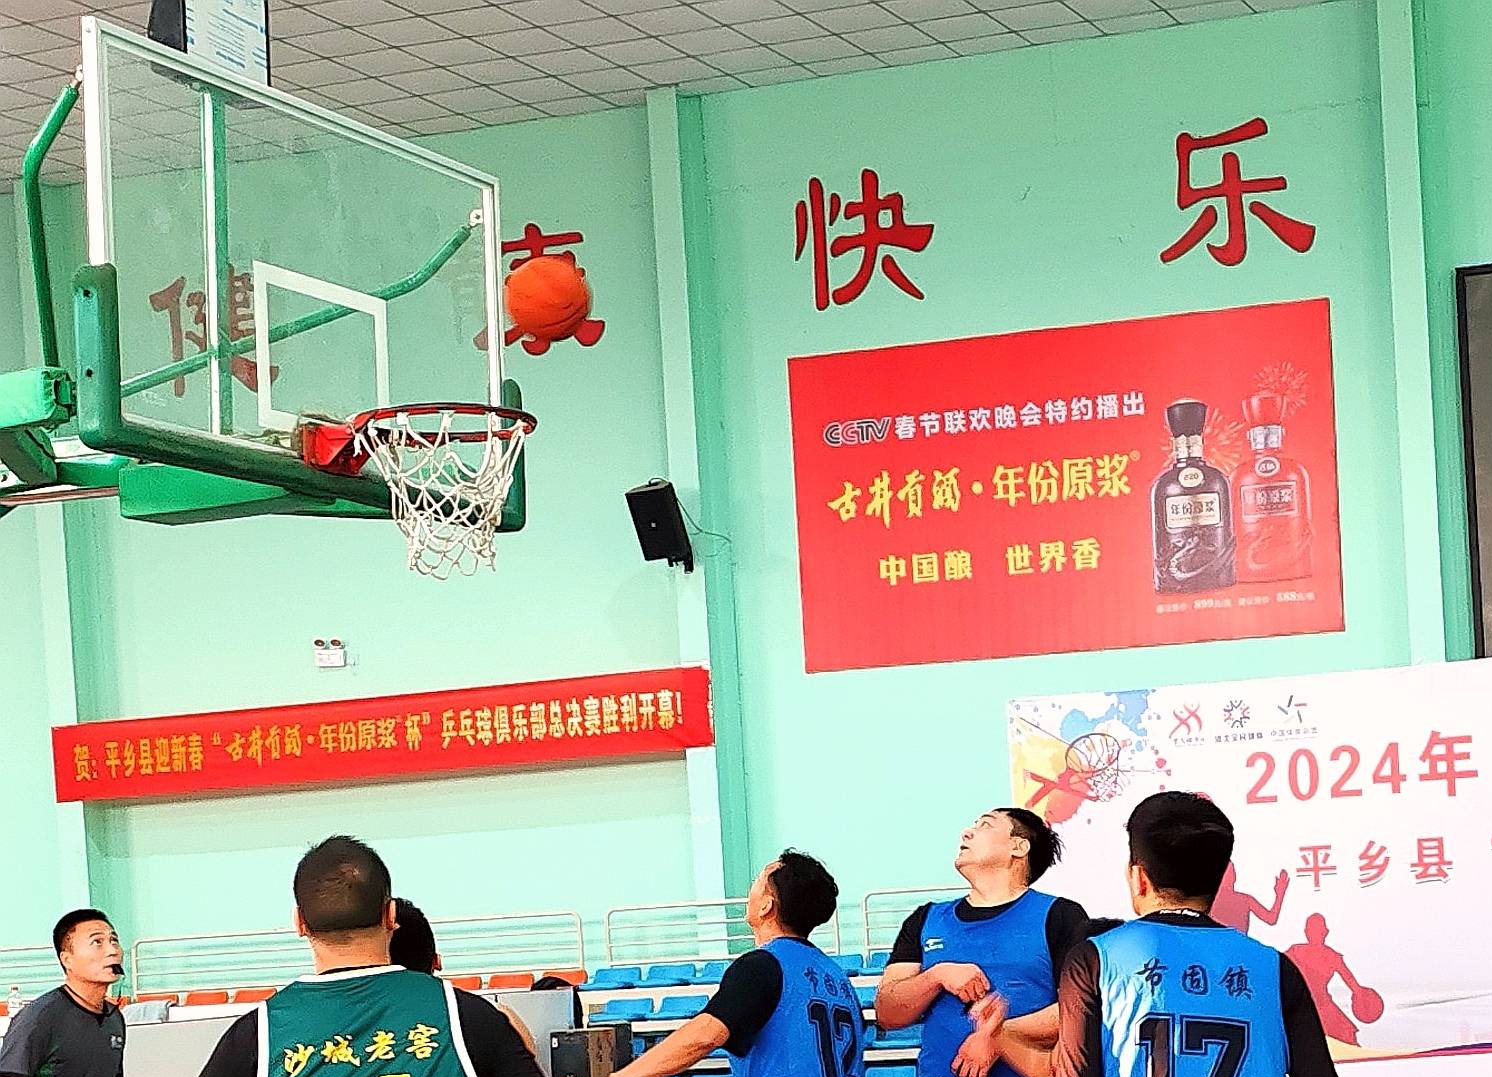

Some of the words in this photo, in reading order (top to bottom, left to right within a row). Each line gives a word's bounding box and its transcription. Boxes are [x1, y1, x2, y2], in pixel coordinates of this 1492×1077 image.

[795, 168, 935, 311] 快
[1160, 117, 1316, 267] 乐
[879, 549, 973, 586] 中国酿
[1004, 537, 1102, 577] 世界香
[1135, 956, 1253, 1001] 节固镇
